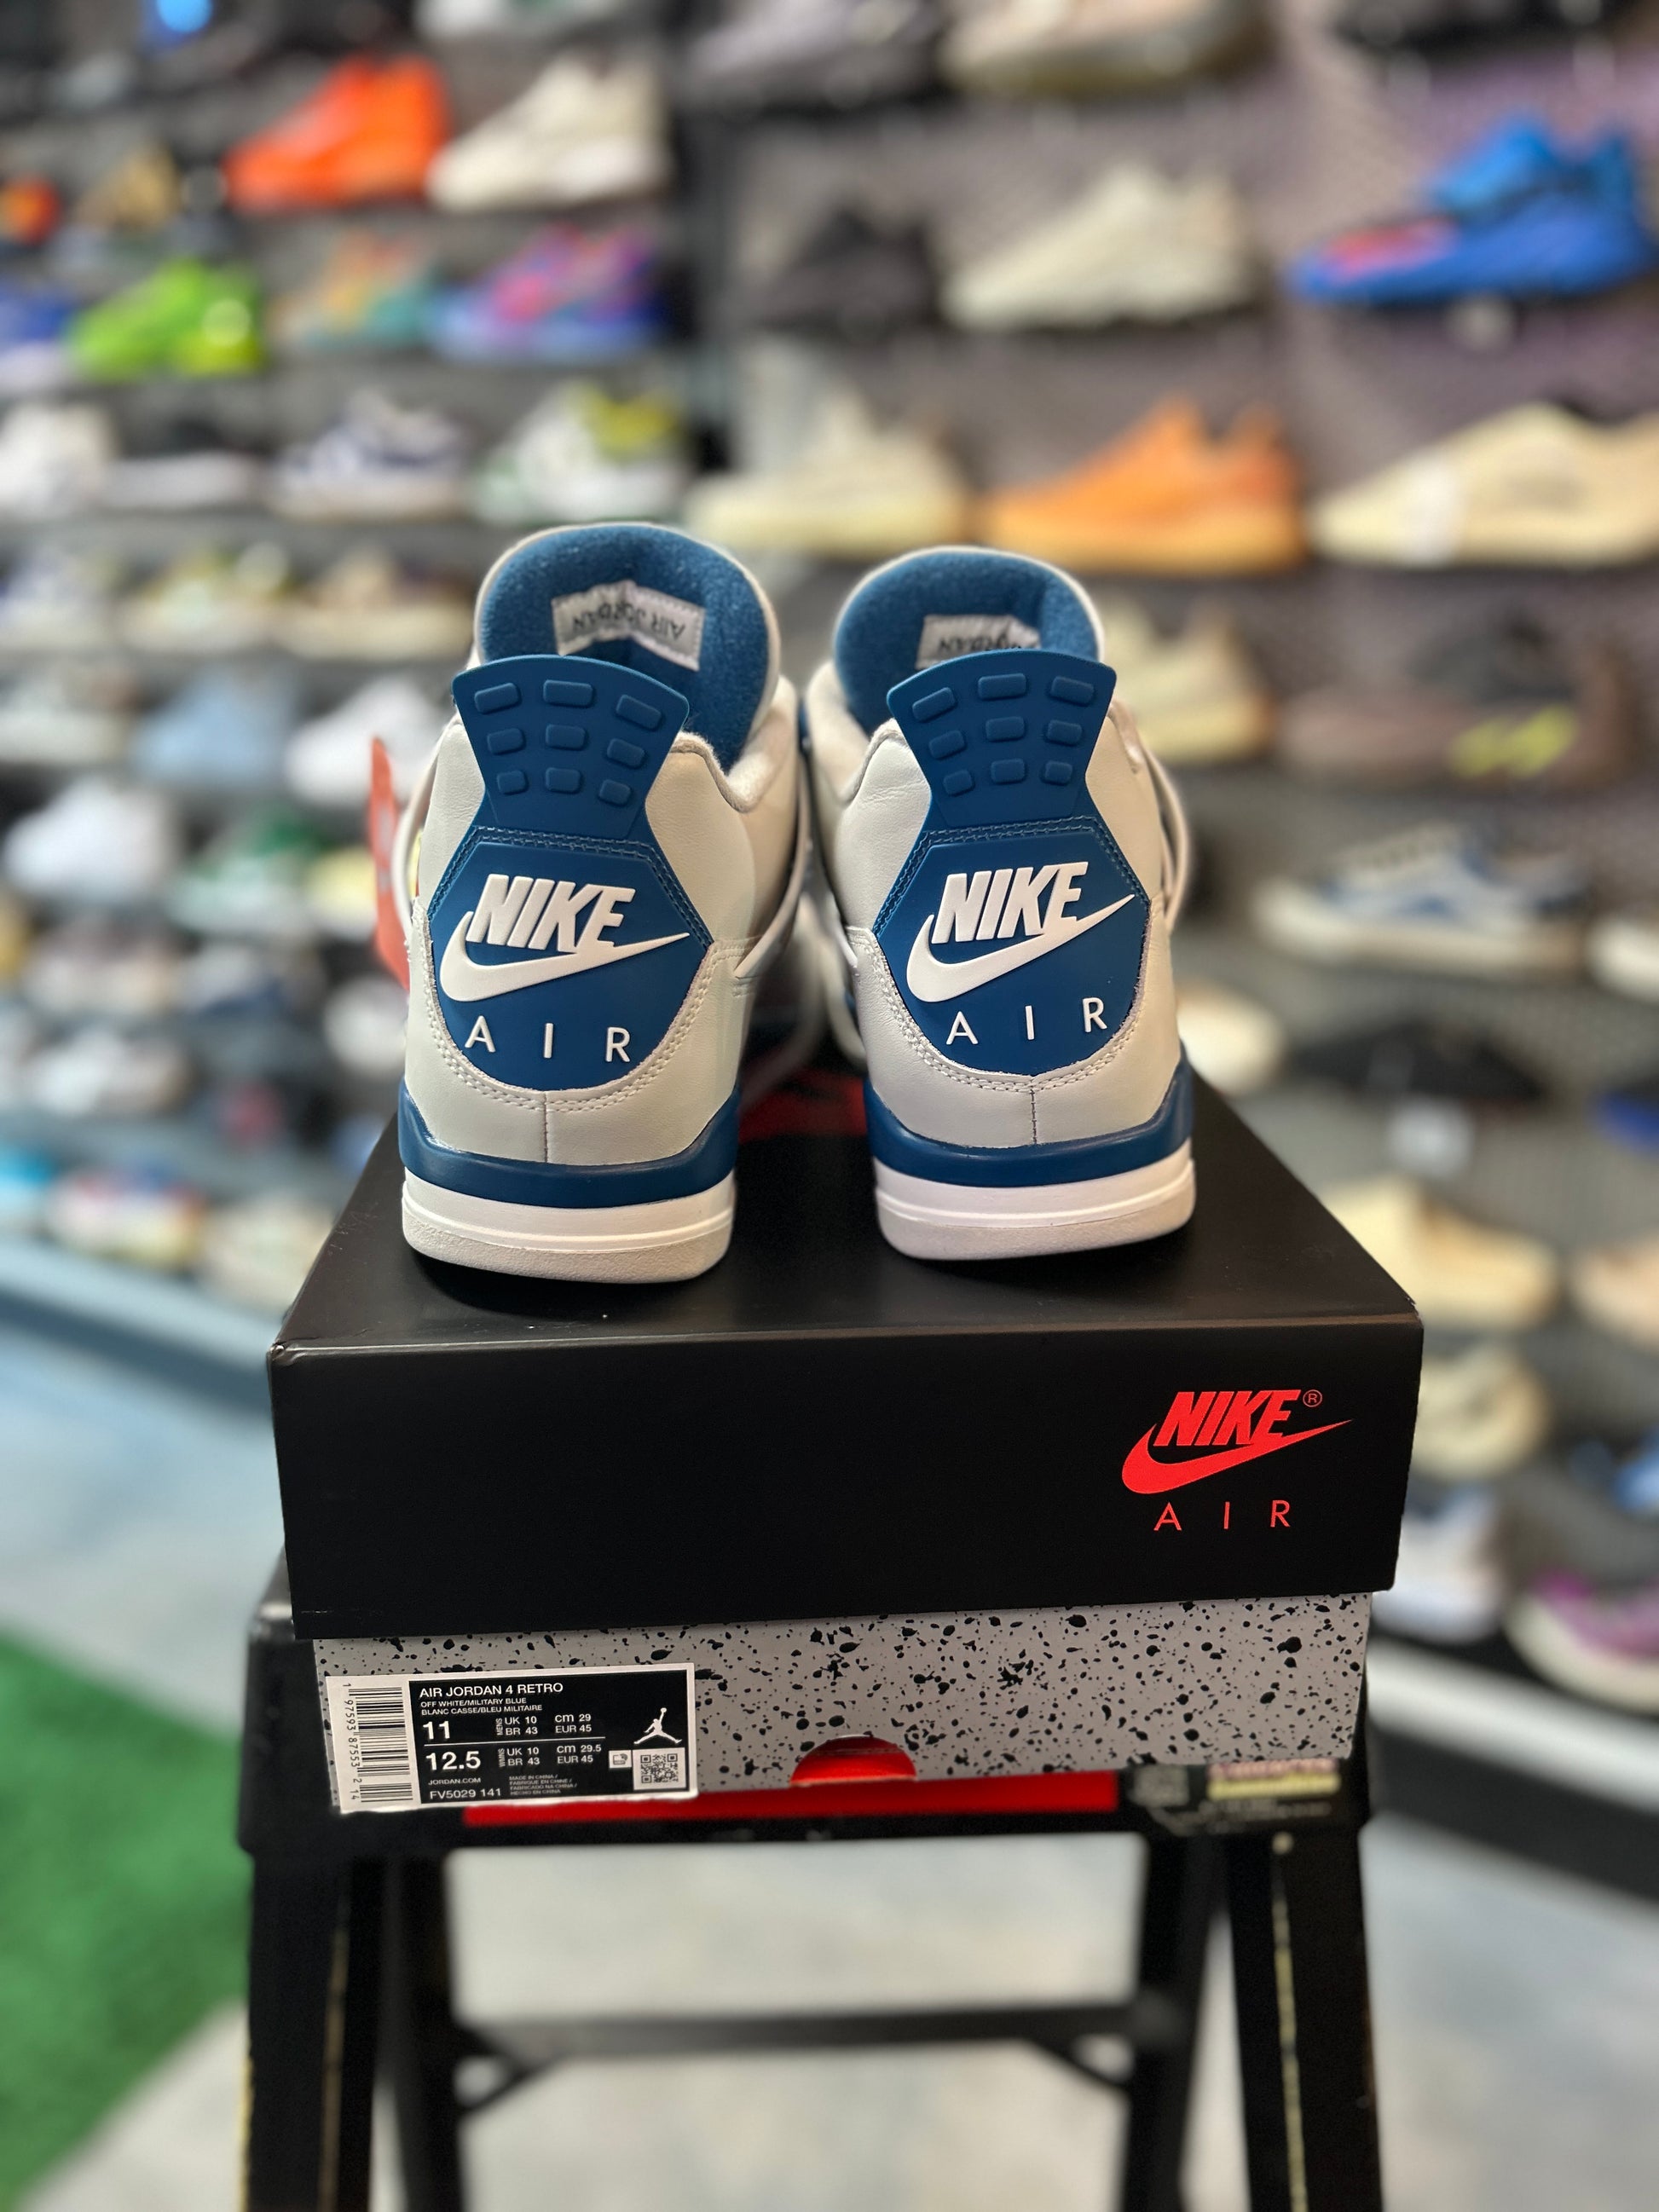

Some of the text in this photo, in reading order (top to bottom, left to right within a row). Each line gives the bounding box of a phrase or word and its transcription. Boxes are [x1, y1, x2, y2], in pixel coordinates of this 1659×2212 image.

[651, 614, 686, 639] AIR
[930, 861, 1089, 944] NIKE
[465, 873, 636, 954] NIKE
[945, 997, 1107, 1045] AIR
[465, 1014, 631, 1063] AIR
[1153, 1499, 1291, 1531] AIR
[419, 1683, 564, 1698] AIR JORDAN 4 RETRO
[438, 1698, 504, 1707] WHITE/MILITARY
[450, 1706, 502, 1715] CASSE/BLEU
[503, 1704, 543, 1712] MILITAIRE
[505, 1717, 521, 1725] UK
[554, 1713, 592, 1723] cm 29
[423, 1720, 450, 1740] 11
[505, 1726, 538, 1736] BR 43
[555, 1725, 577, 1734] EUR
[506, 1747, 540, 1756] UK 10
[557, 1744, 602, 1753] cm 29.5
[425, 1750, 482, 1770] 12.5
[528, 1757, 540, 1765] 43
[558, 1754, 593, 1764] EUR 45
[428, 1777, 482, 1786] JORDAN.COM
[430, 1788, 501, 1799] FV5029 141
